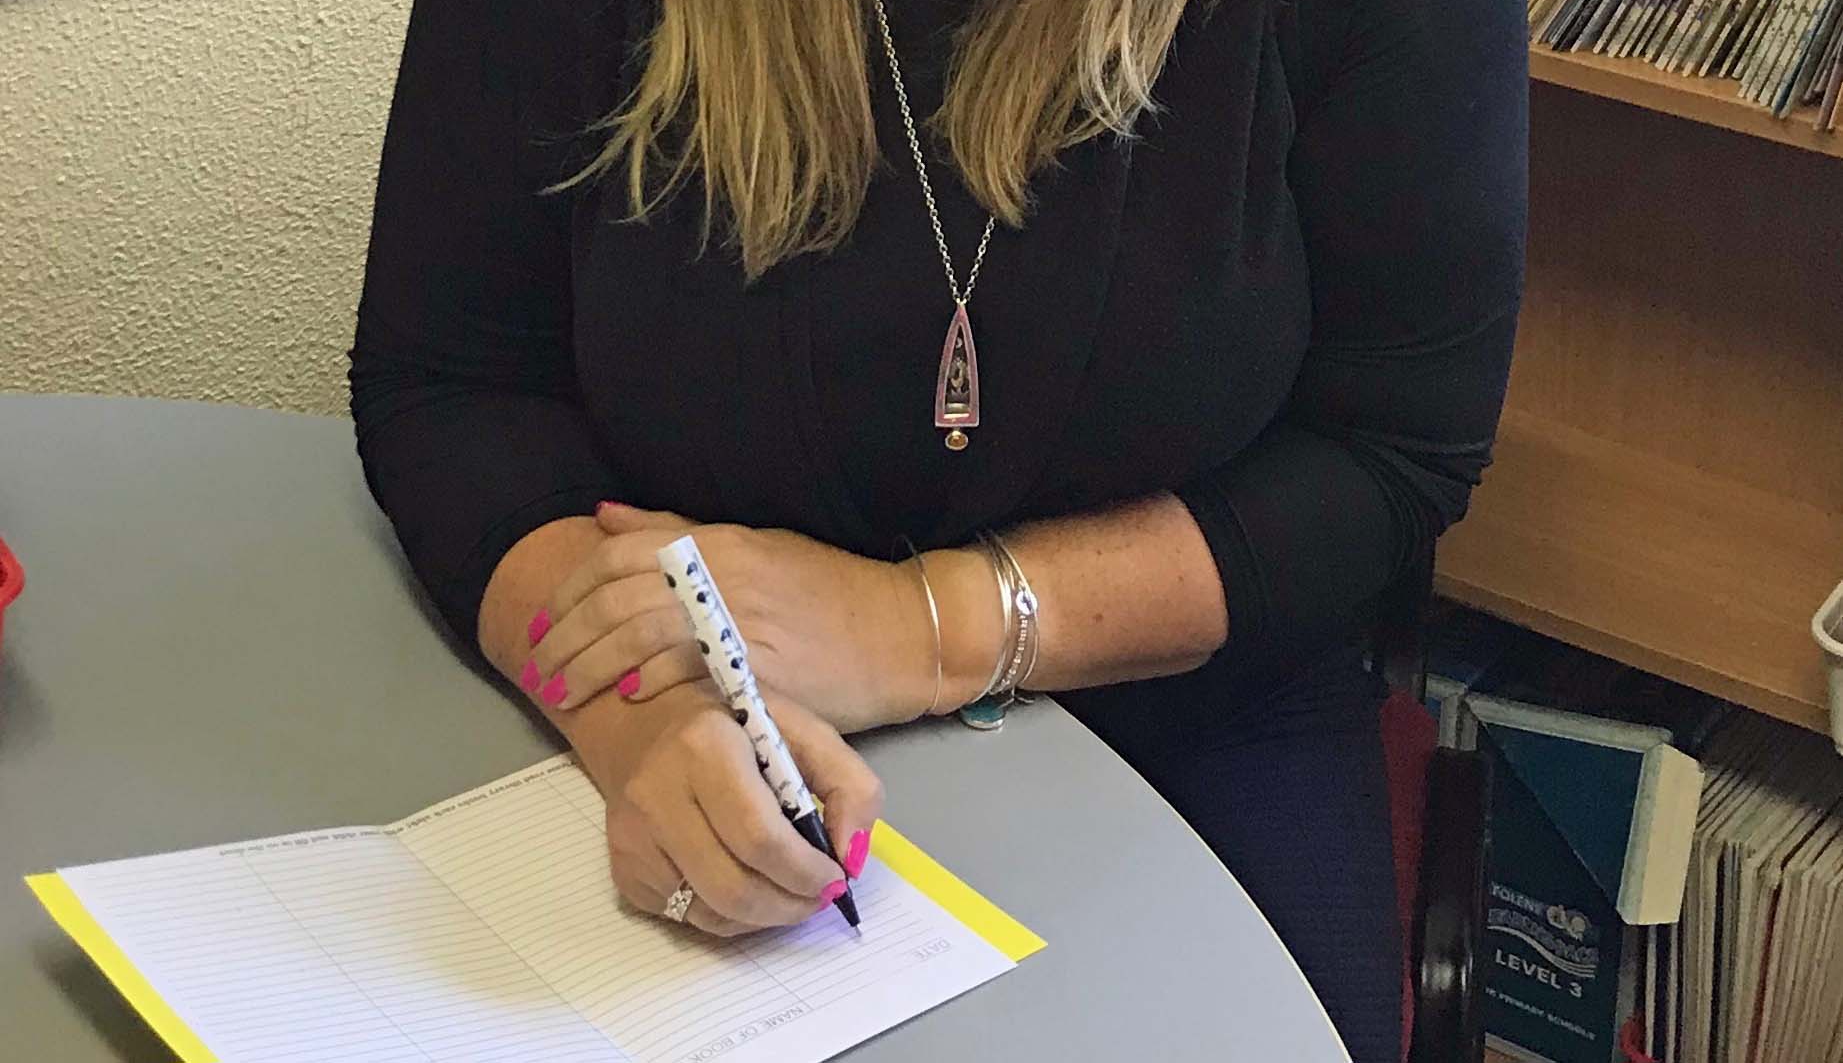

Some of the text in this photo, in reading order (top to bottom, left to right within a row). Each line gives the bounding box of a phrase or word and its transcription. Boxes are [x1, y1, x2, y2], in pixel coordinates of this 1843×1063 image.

[916, 938, 950, 960] DATE
[1495, 948, 1582, 998] LEVEL 3
[693, 1006, 803, 1063] NAME OF BOOK
